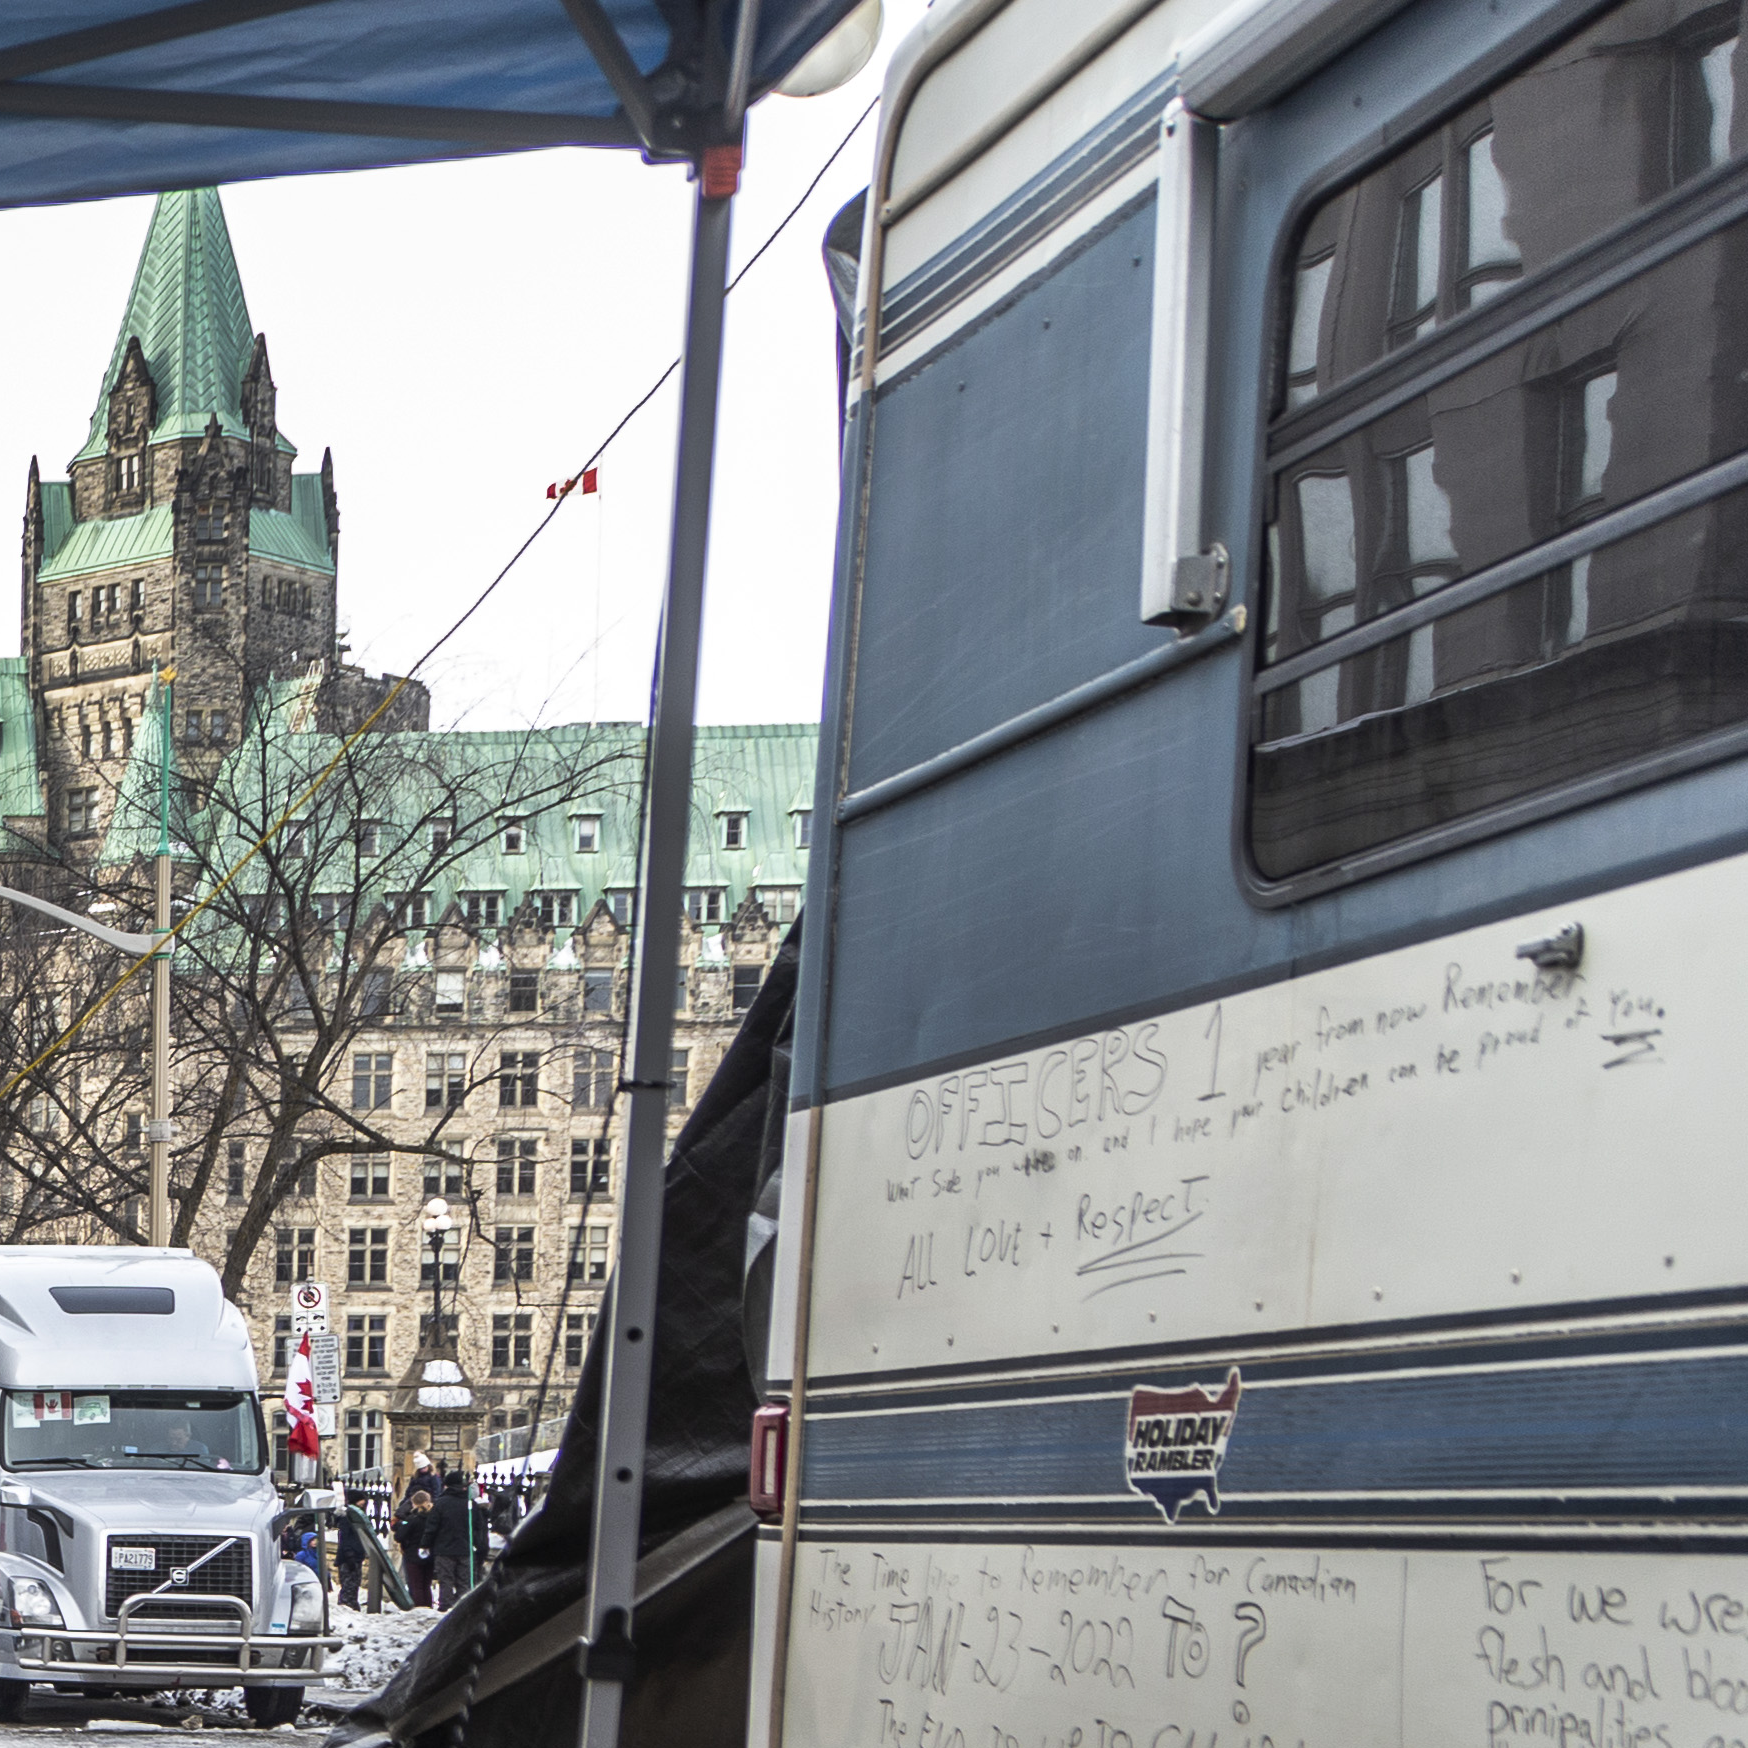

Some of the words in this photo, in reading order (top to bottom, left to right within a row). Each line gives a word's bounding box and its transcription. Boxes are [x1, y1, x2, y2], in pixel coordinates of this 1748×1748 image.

[906, 1022, 1168, 1160] OFFICERS
[1252, 1038, 1301, 1098] year
[1314, 1005, 1365, 1051] from
[1376, 1002, 1426, 1035] now
[1174, 1114, 1212, 1144] hope
[1389, 1061, 1419, 1083] can
[1435, 1043, 1461, 1075] be
[1476, 1012, 1545, 1071] proud
[1133, 1416, 1227, 1448] HOLIDAY
[1133, 1449, 1215, 1472] RAMBLER
[978, 1556, 1003, 1597] to
[1189, 1553, 1231, 1590] for
[1246, 1554, 1357, 1604] Canadian
[1478, 1556, 1543, 1616] For
[1569, 1583, 1634, 1627] we
[1658, 1590, 1748, 1638] wre
[1232, 1600, 1267, 1726] ?
[1475, 1624, 1567, 1692] flesh
[1581, 1644, 1660, 1703] and
[1682, 1646, 1748, 1716] bloo
